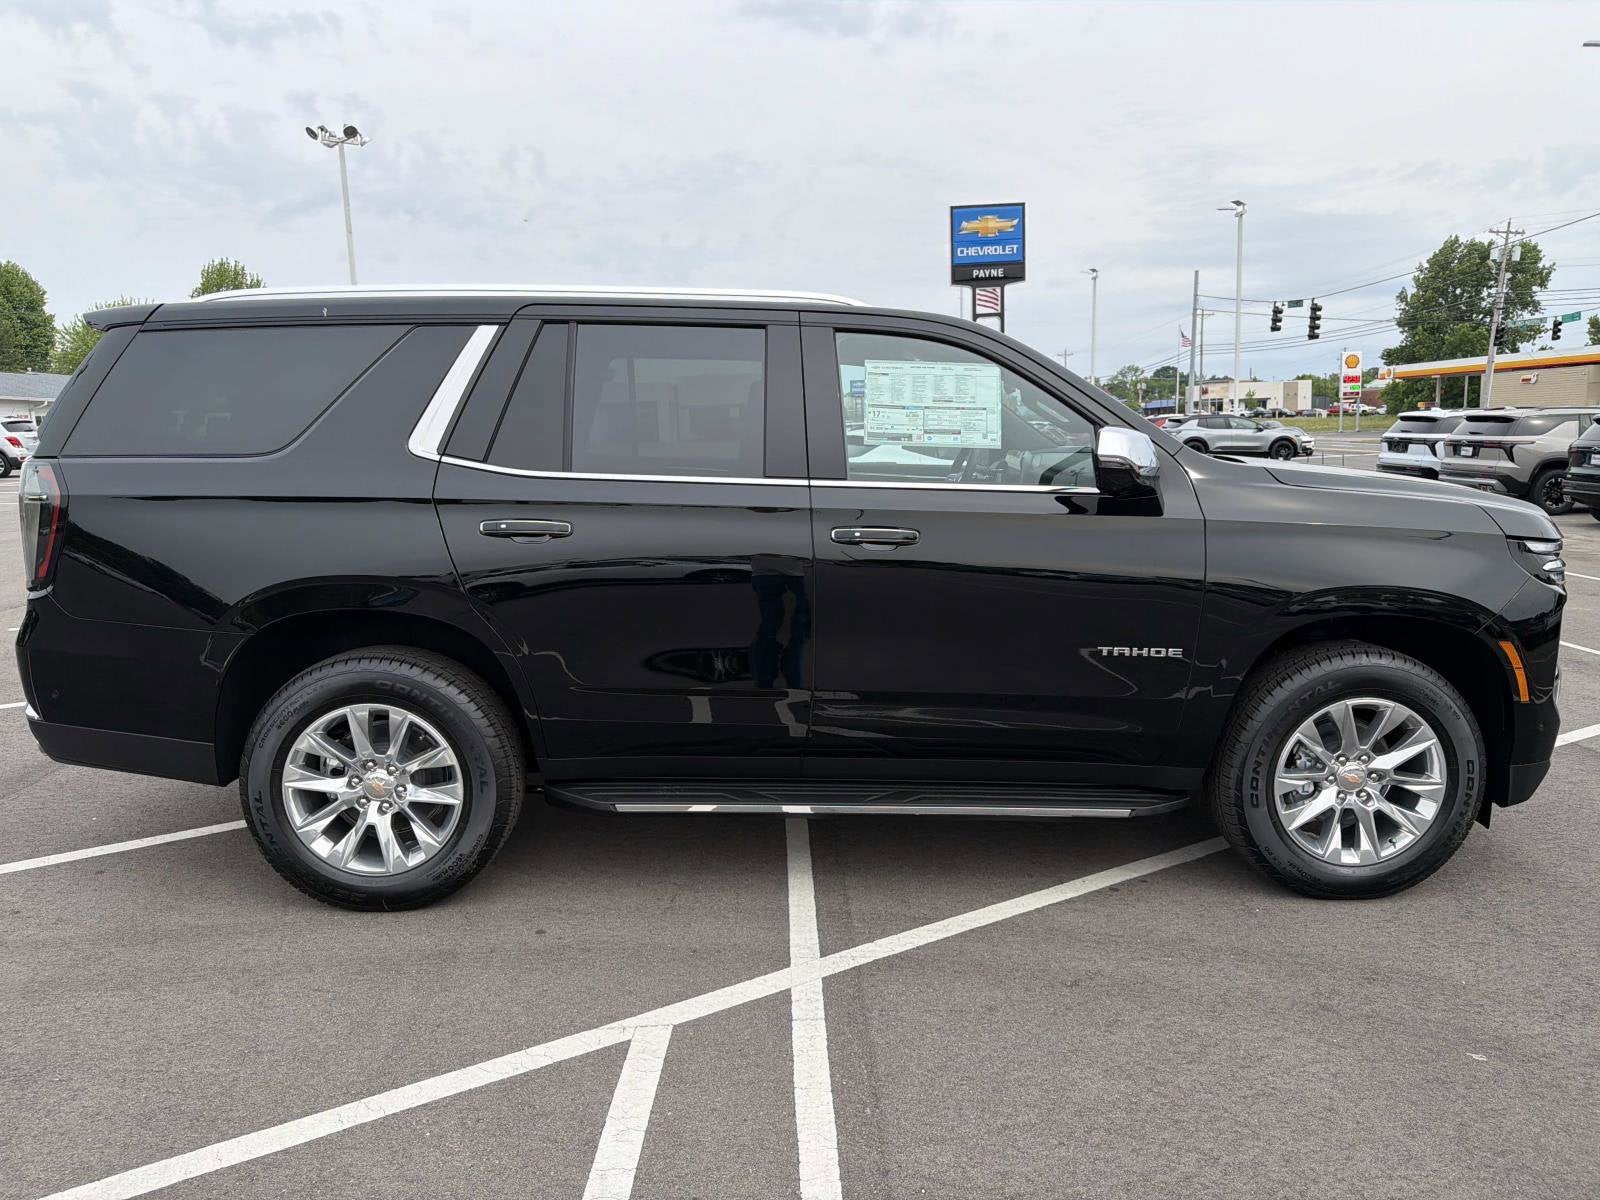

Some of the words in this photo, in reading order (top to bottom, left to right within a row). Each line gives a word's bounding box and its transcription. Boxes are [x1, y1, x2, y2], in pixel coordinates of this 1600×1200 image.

[957, 244, 1019, 257] CHEVROLET
[972, 268, 1004, 279] PAYNE
[1097, 646, 1184, 658] TAHOE
